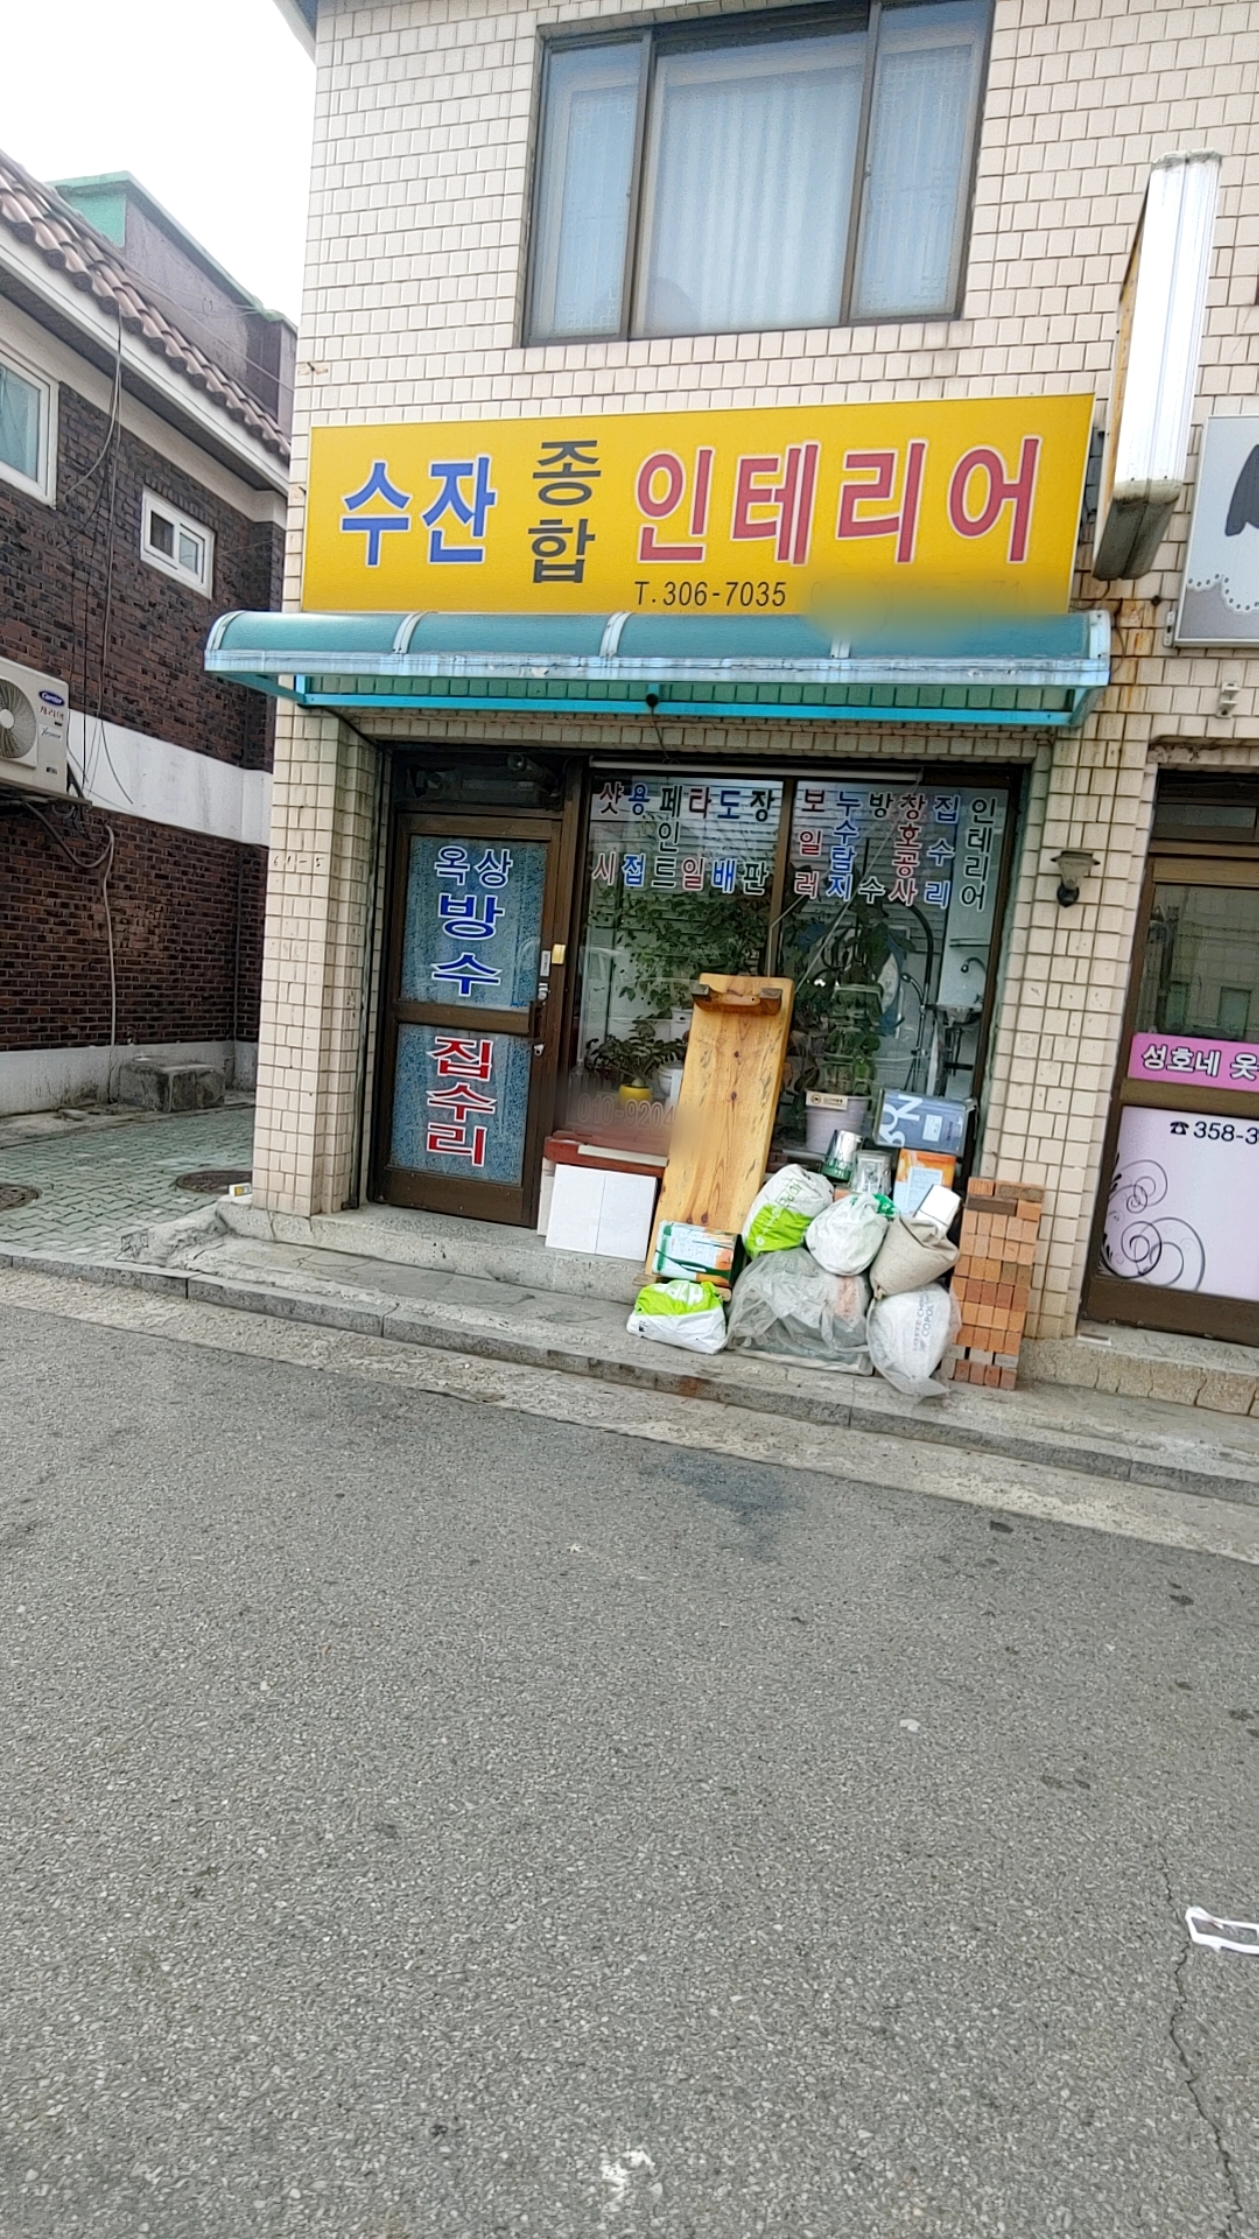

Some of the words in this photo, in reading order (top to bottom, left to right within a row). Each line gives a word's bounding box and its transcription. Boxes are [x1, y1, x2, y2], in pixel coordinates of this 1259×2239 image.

[341, 454, 497, 567] 수잔
[528, 440, 602, 584] 종합
[635, 435, 1041, 567] 인테리어
[434, 845, 514, 889] 옥상
[622, 783, 650, 888] 용접
[651, 785, 684, 889] 페인트
[681, 786, 712, 891] 타일
[711, 789, 741, 894] 도배
[742, 788, 776, 896] 장판
[794, 788, 825, 900] 보일러
[826, 791, 861, 902] 누수탐지
[858, 792, 894, 905] 방수
[888, 793, 927, 907] 창호공사
[924, 795, 961, 910] 집수리
[960, 797, 996, 912] 인테리어
[431, 893, 505, 997] 방수
[426, 1036, 498, 1167] 집수리
[1142, 1043, 1222, 1078] 성호네
